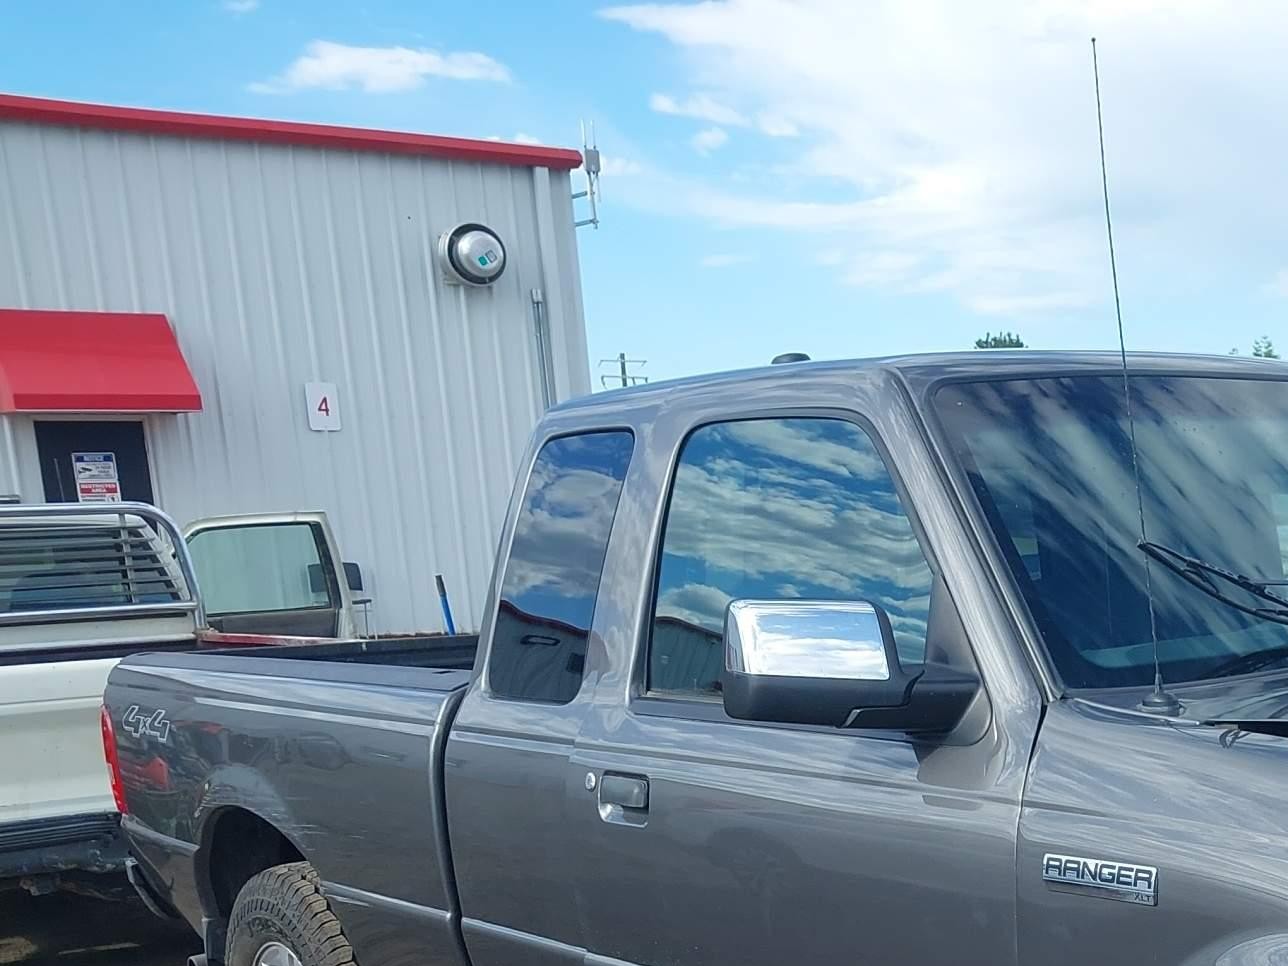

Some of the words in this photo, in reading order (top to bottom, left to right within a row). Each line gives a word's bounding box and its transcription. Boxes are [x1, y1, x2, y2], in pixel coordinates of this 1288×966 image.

[317, 396, 330, 417] 4
[122, 705, 170, 744] 4x4
[1044, 857, 1153, 889] RANGER
[1133, 893, 1152, 902] XLT
